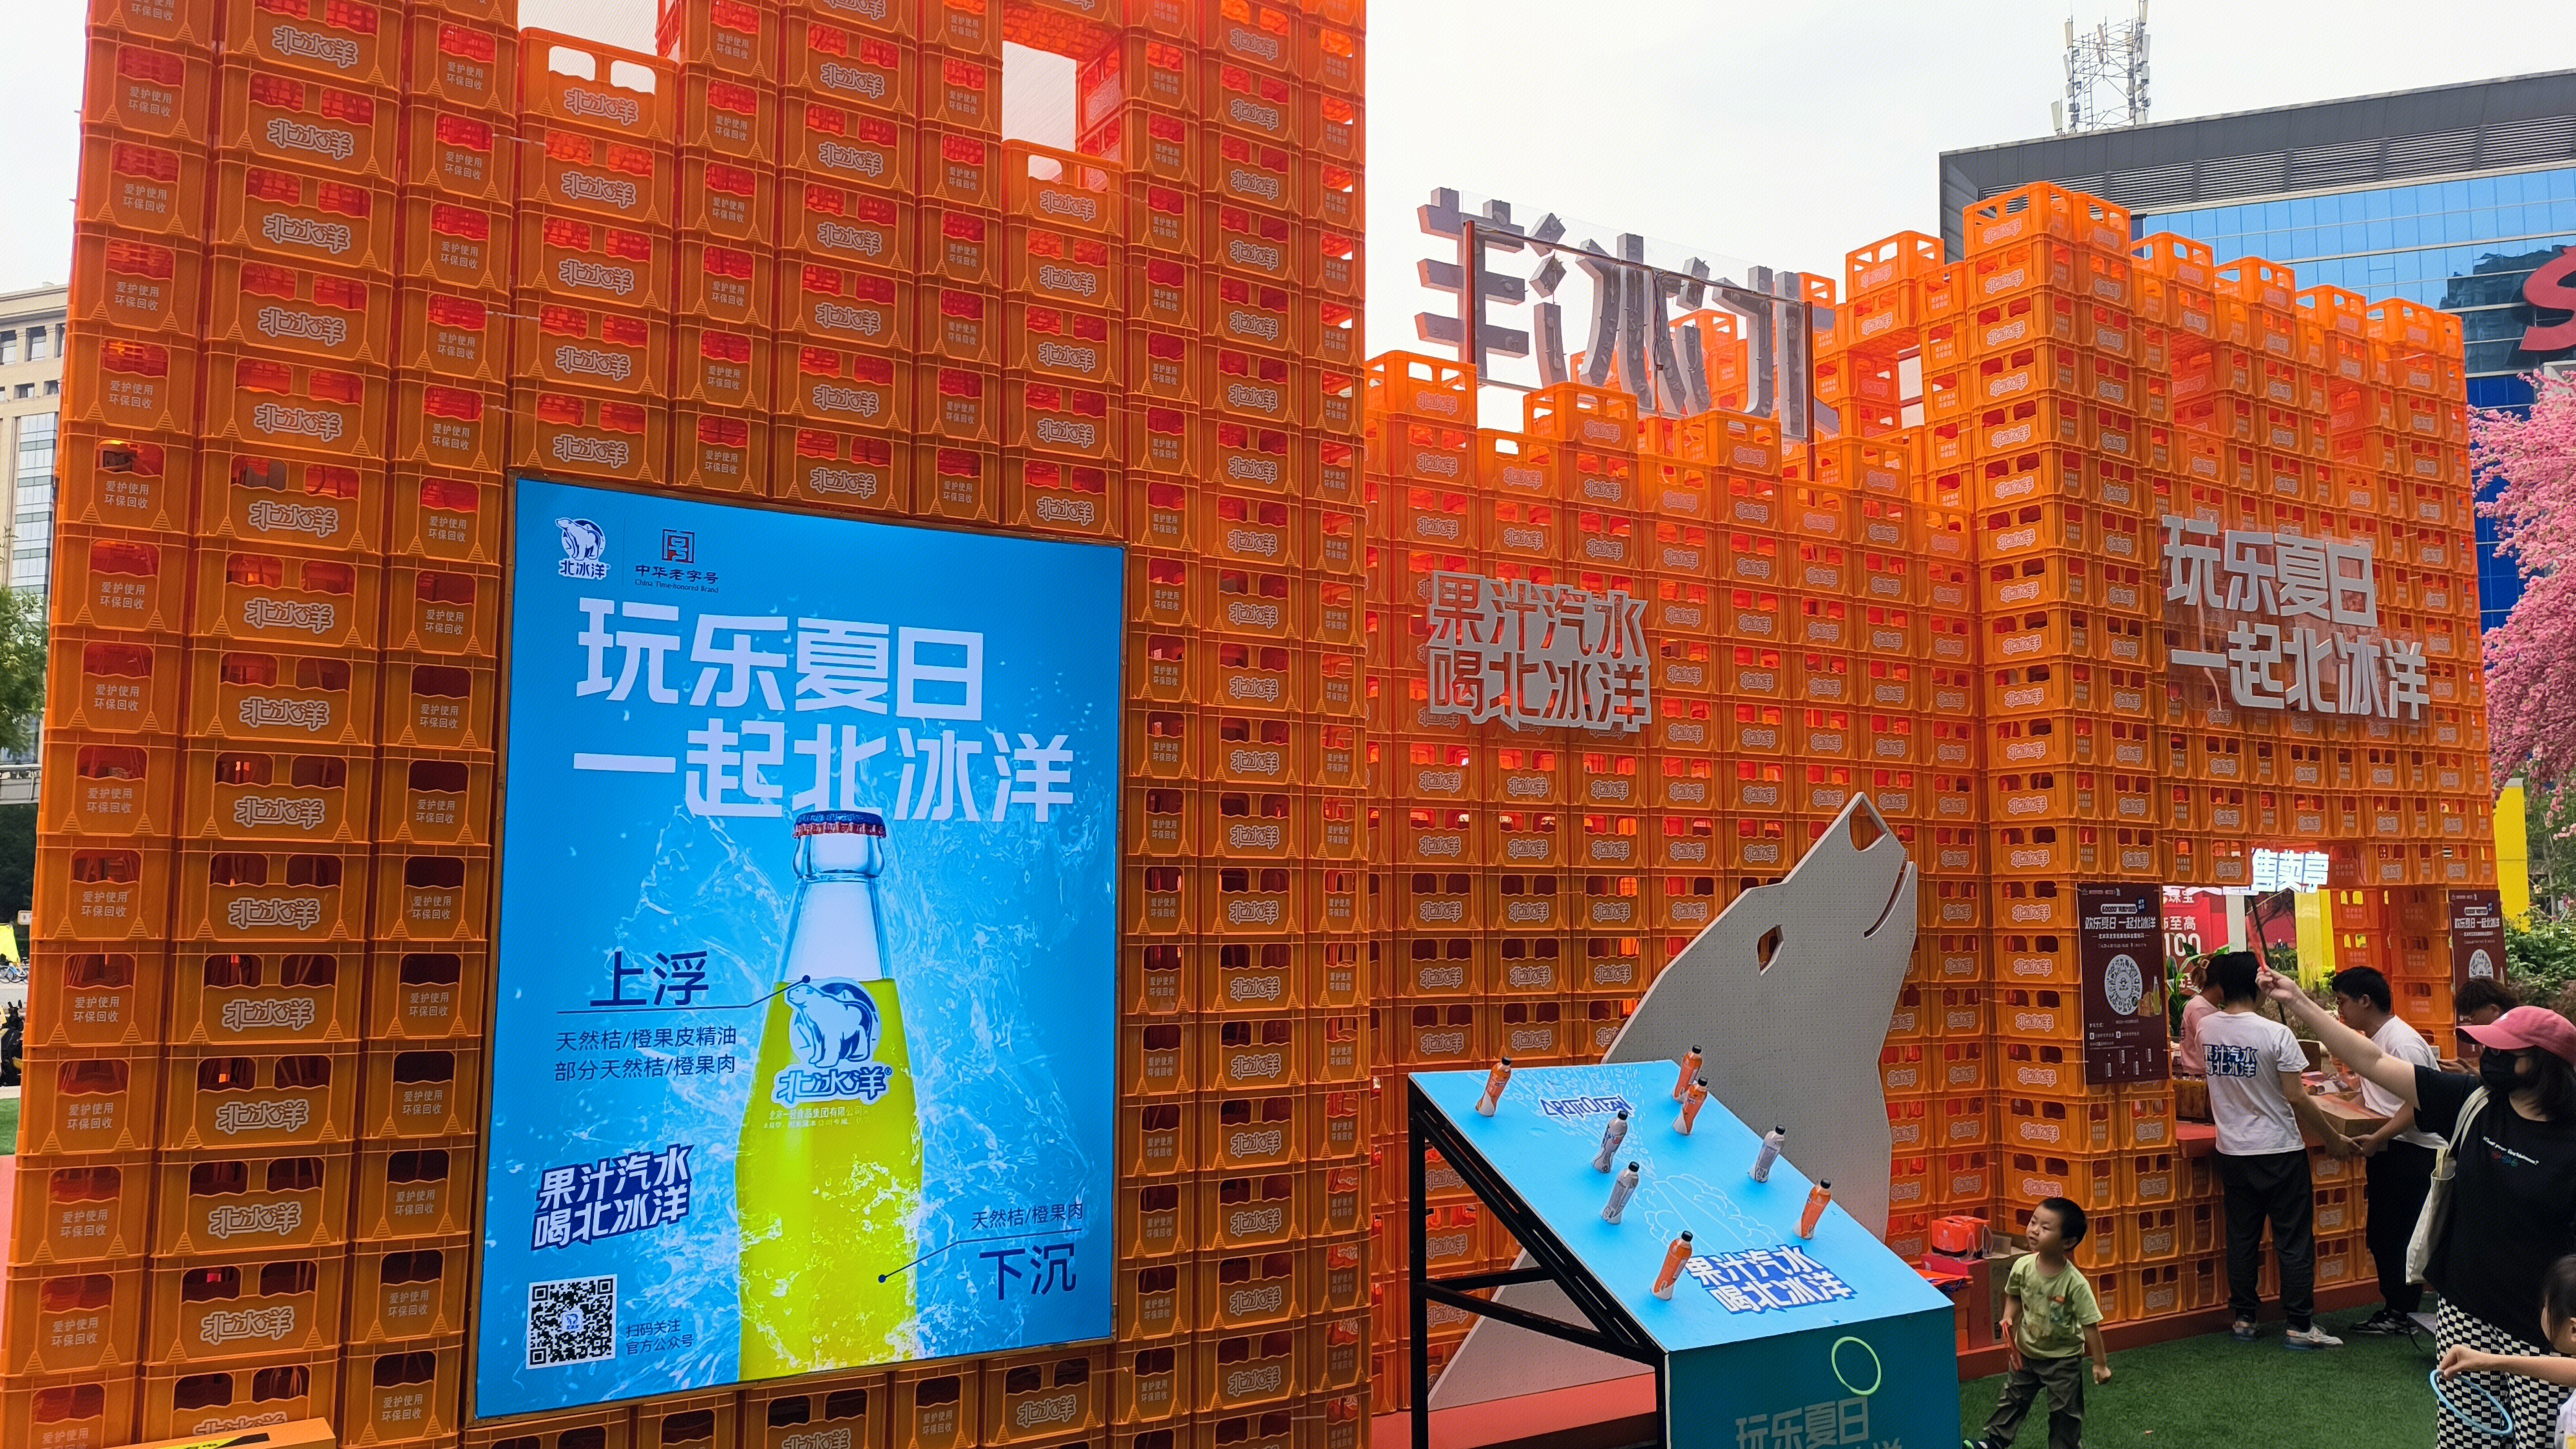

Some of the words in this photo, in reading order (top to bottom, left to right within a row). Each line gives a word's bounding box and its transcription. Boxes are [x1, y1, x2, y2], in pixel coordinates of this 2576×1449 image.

[271, 25, 359, 69] 北冰洋
[820, 62, 886, 99] 北冰洋
[564, 87, 639, 126] 北冰洋
[1230, 99, 1279, 130] 北冰洋
[266, 118, 354, 161] 北冰洋
[818, 142, 884, 177] 北冰洋
[125, 183, 167, 201] 爱护使用
[561, 170, 637, 209] 北冰洋
[123, 195, 166, 214] 环保回收
[1039, 190, 1097, 221] 北冰洋
[262, 212, 351, 255] 北冰洋
[817, 221, 883, 256] 北冰洋
[441, 241, 479, 257] 爱护使用
[1230, 240, 1279, 270] 北冰洋
[440, 253, 478, 269] 环保回收
[558, 258, 635, 296] 北冰洋
[1039, 265, 1097, 297] 北冰洋
[1985, 269, 2025, 295] 北冰洋
[116, 281, 160, 297] 爱护使用
[114, 294, 158, 312] 环保回收
[257, 306, 347, 347] 北冰洋
[815, 302, 882, 336] 北冰洋
[1986, 321, 2026, 347] 北冰洋
[554, 345, 632, 382] 北冰洋
[1038, 341, 1096, 373] 北冰洋
[110, 380, 154, 395] 爱护使用
[1228, 383, 1278, 413] 北冰洋
[108, 393, 153, 410] 环保回收
[812, 384, 880, 417] 北冰洋
[253, 402, 343, 443] 北冰洋
[432, 423, 471, 438] 爱护使用
[1037, 417, 1095, 448] 北冰洋
[432, 436, 469, 451] 环保回收
[1990, 424, 2031, 449] 北冰洋
[552, 433, 629, 468] 北冰洋
[1416, 452, 1459, 476] 北冰洋
[106, 480, 149, 495] 爱护使用
[810, 466, 877, 499] 北冰洋
[1503, 466, 1544, 489] 北冰洋
[104, 493, 148, 509] 环保回收
[1584, 478, 1622, 501] 北冰洋
[247, 500, 339, 538] 北冰洋
[1036, 496, 1095, 525] 北冰洋
[429, 515, 467, 530] 爱护使用
[1417, 516, 1459, 539] 北冰洋
[428, 528, 465, 543] 环保回收
[1227, 528, 1278, 556] 北冰洋
[1996, 528, 2037, 551] 北冰洋
[560, 560, 605, 578] 北冰洋
[636, 564, 719, 584] 中华老字号
[2162, 515, 2377, 626] 玩乐夏日
[101, 581, 146, 596] 爱护使用
[99, 595, 145, 610] 环保回收
[243, 597, 335, 634] 北冰洋
[1428, 571, 1648, 660] 果汁汽水
[2002, 634, 2042, 655] 北冰洋
[576, 597, 983, 721] 玩乐夏日
[2172, 621, 2430, 720] 一起北冰洋
[95, 684, 140, 698] 爱护使用
[1229, 675, 1279, 701] 北冰洋
[1429, 650, 1652, 731] 喝北冰洋
[94, 697, 138, 712] 环保回收
[238, 695, 330, 732] 北冰洋
[420, 703, 459, 716] 爱护使用
[419, 716, 458, 729] 环保回收
[2006, 741, 2047, 760] 北冰洋
[574, 720, 1074, 822] 一起北冰洋
[1418, 771, 1463, 794] 北冰洋
[88, 787, 133, 800] 爱护使用
[1507, 776, 1550, 796] 北冰洋
[1591, 780, 1629, 800] 北冰洋
[1668, 782, 1705, 802] 北冰洋
[86, 800, 132, 814] 环保回收
[232, 795, 326, 830] 北冰洋
[417, 799, 456, 811] 爱护使用
[415, 811, 454, 824] 环保回收
[1230, 824, 1280, 849] 北冰洋
[1507, 838, 1549, 858] 北冰洋
[2010, 848, 2051, 868] 北冰洋
[82, 891, 128, 904] 爱护使用
[81, 905, 127, 918] 环保回收
[227, 897, 321, 930] 北冰洋
[1228, 900, 1280, 924] 北冰洋
[1419, 900, 1463, 921] 北冰洋
[1592, 902, 1631, 921] 北冰洋
[589, 950, 710, 1007] 上浮
[1509, 965, 1552, 987] 北冰洋
[2012, 958, 2053, 976] 北冰洋
[75, 996, 120, 1009] 爱护使用
[410, 991, 449, 1004] 爱护使用
[73, 1010, 119, 1022] 环保回收
[221, 997, 316, 1032] 北冰洋
[409, 1006, 448, 1017] 环保回收
[556, 1025, 737, 1052] 天然桔/橙果皮精油
[1420, 1032, 1465, 1054] 北冰洋
[554, 1054, 736, 1082] 部分天然桔/橙果肉
[1230, 1052, 1282, 1080] 北冰洋
[2017, 1067, 2057, 1087] 北冰洋
[776, 1066, 886, 1104] 北冰洋
[69, 1102, 114, 1117] 爱护使用
[215, 1098, 310, 1135] 北冰洋
[67, 1117, 112, 1130] 环保回收
[2020, 1121, 2061, 1143] 北冰洋
[1230, 1130, 1282, 1157] 北冰洋
[540, 1146, 691, 1210] 果汁汽水
[395, 1189, 436, 1202] 爱护使用
[62, 1209, 108, 1224] 爱护使用
[207, 1200, 303, 1239] 北冰洋
[395, 1203, 434, 1216] 环保回收
[534, 1185, 689, 1248] 喝北冰洋
[972, 1202, 1084, 1231] 天然桔/橙果肉
[60, 1224, 106, 1238] 环保回收
[979, 1242, 1076, 1300] 下沉
[1685, 1245, 1824, 1285] 果汁汽水
[1229, 1286, 1282, 1315] 北冰洋
[1709, 1271, 1852, 1312] 喝北冰洋
[53, 1317, 99, 1333] 爱护使用
[199, 1305, 295, 1346] 北冰洋
[626, 1319, 681, 1337] 扫码关注
[51, 1332, 97, 1347] 环保回收
[626, 1334, 694, 1355] 官方公众号
[384, 1393, 423, 1409] 爱护使用
[1017, 1394, 1077, 1428] 北冰洋
[382, 1408, 421, 1422] 环保回收
